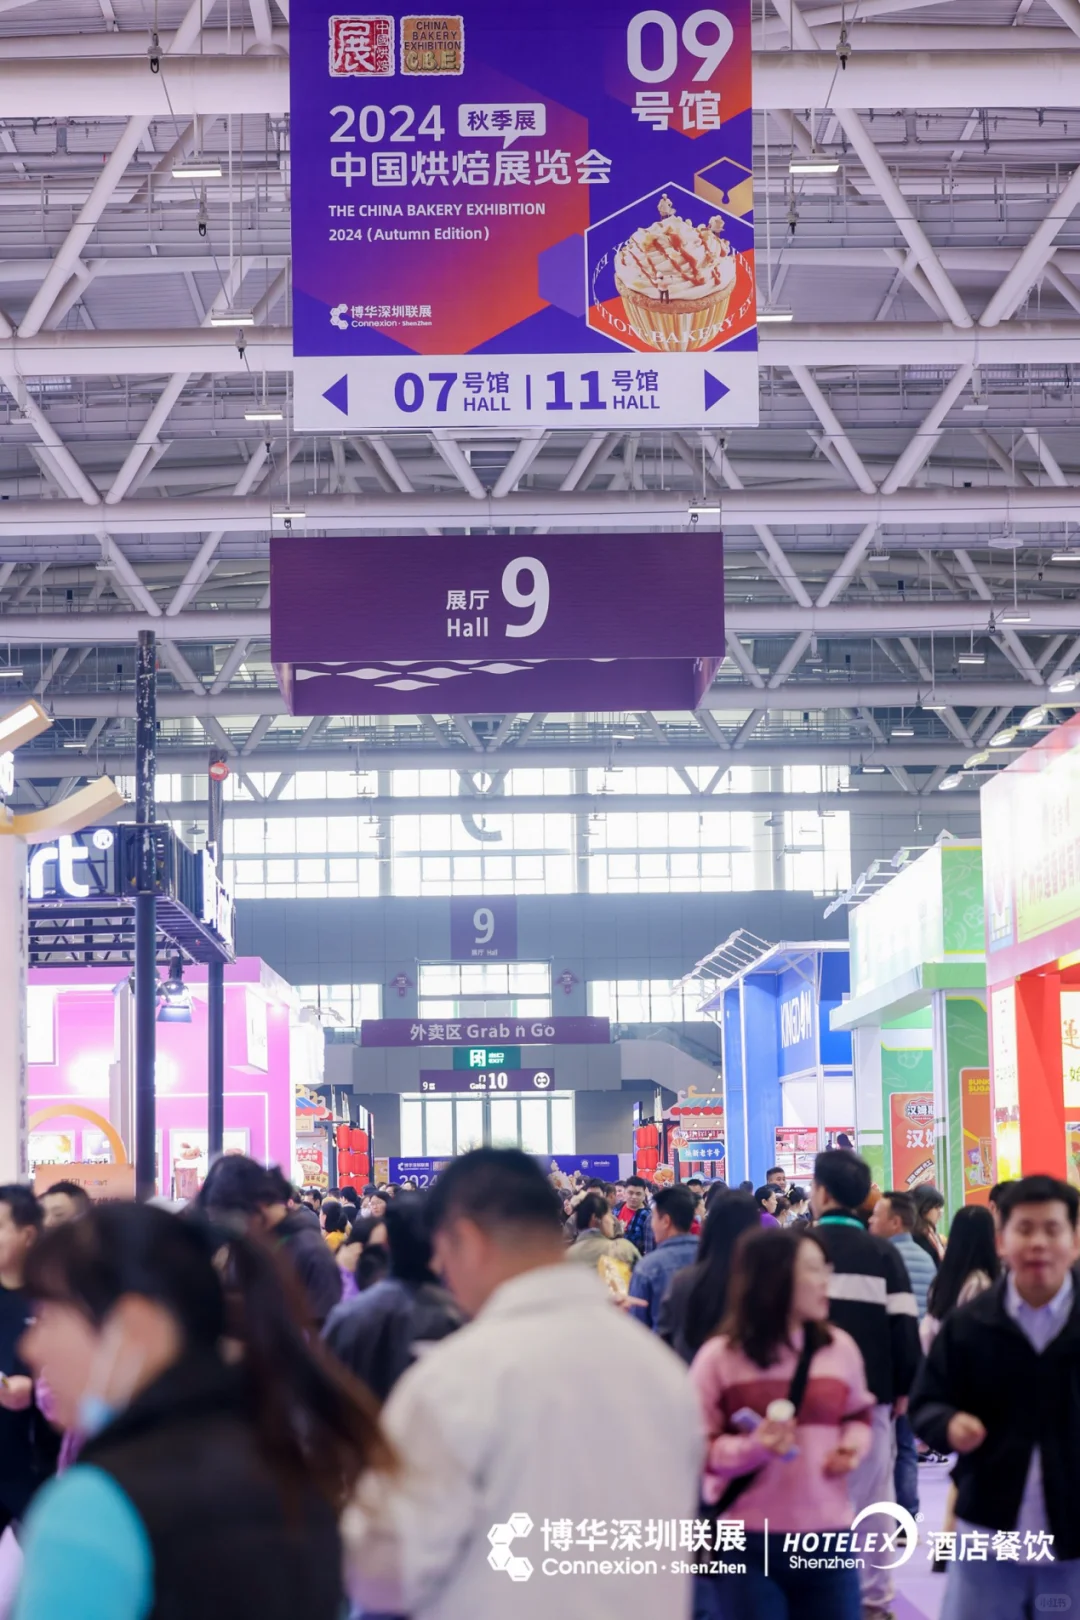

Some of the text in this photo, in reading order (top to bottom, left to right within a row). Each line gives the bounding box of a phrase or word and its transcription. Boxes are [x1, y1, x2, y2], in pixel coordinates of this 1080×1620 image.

[416, 21, 448, 30] CHINA
[404, 41, 461, 51] EXHIBITION
[412, 31, 457, 41] BAKERY
[627, 9, 734, 83] 09
[467, 110, 536, 131] 秋季展
[631, 90, 721, 131] 号馆
[329, 104, 445, 142] 2024
[330, 149, 613, 188] 中国烘焙展览会
[328, 203, 546, 217] THE CHINA BAKERY EXHIBITION
[329, 229, 363, 241] 2024
[351, 305, 432, 318] 博华深圳联展
[351, 320, 397, 328] Connexion
[462, 371, 509, 394] 号馆
[546, 371, 607, 410] 11
[612, 369, 659, 392] 号馆
[394, 372, 458, 413] 07
[613, 395, 660, 410] HALL
[464, 397, 511, 411] HALL
[446, 590, 489, 610] 展厅
[501, 556, 550, 638] 9
[447, 617, 489, 637] Hall
[473, 907, 495, 944] 9
[410, 1022, 556, 1040] 外卖区 Grab n Go
[469, 1082, 487, 1090] Gate
[488, 1072, 508, 1089] 10
